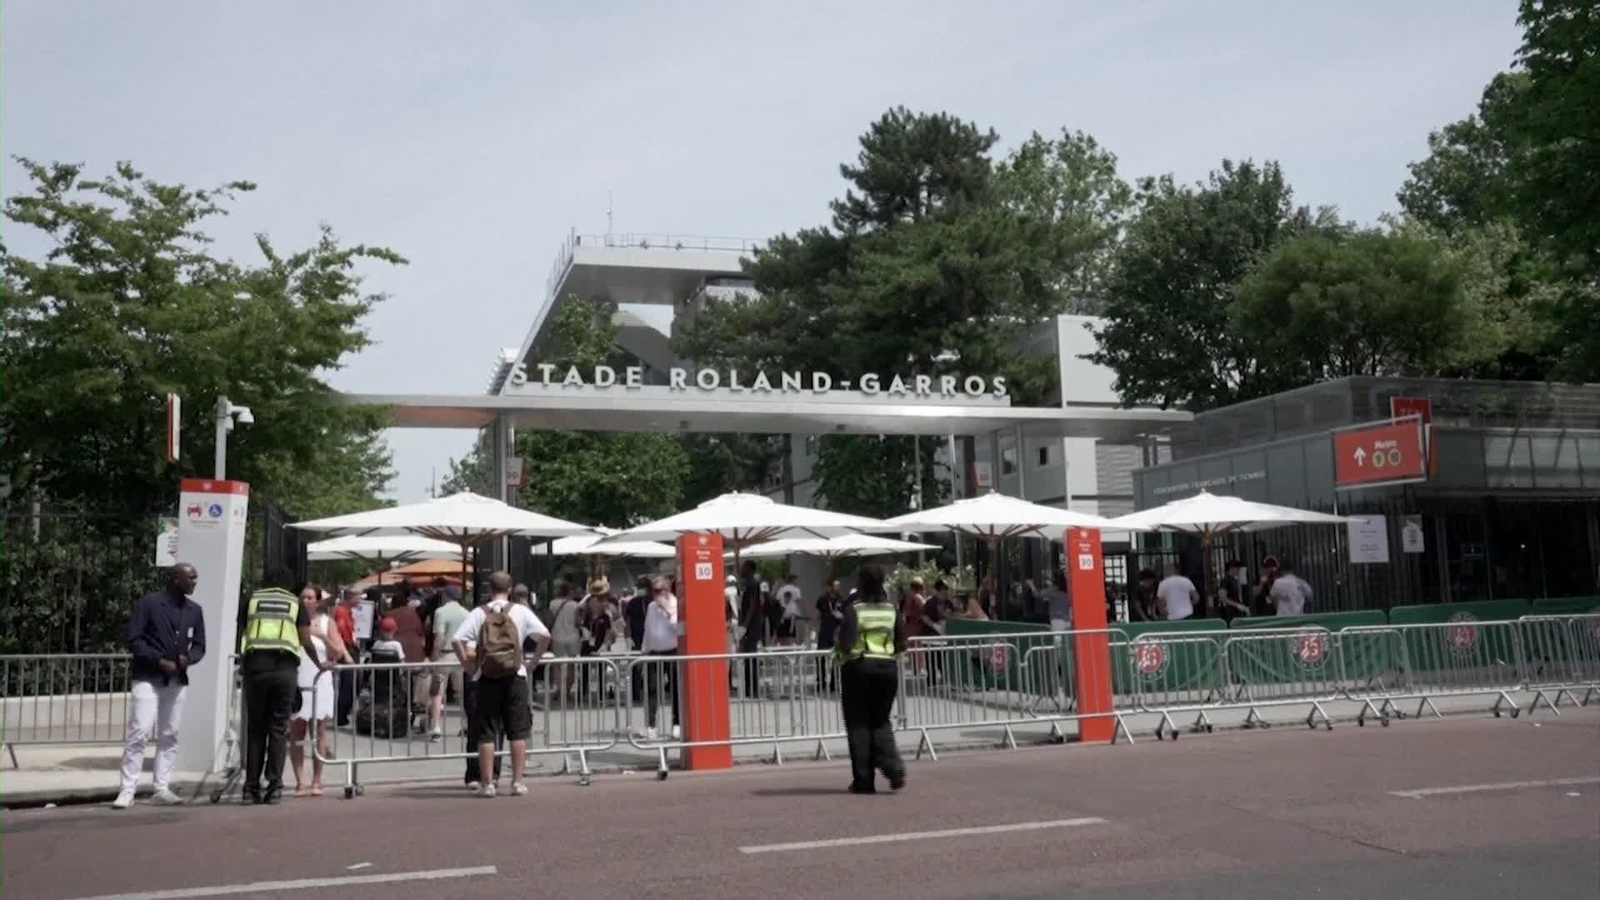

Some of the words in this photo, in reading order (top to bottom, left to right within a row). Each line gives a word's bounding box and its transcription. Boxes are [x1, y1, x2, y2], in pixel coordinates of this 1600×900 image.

[511, 363, 643, 388] STADE
[669, 367, 1007, 396] ROLAND-GARROS
[698, 566, 711, 577] 30
